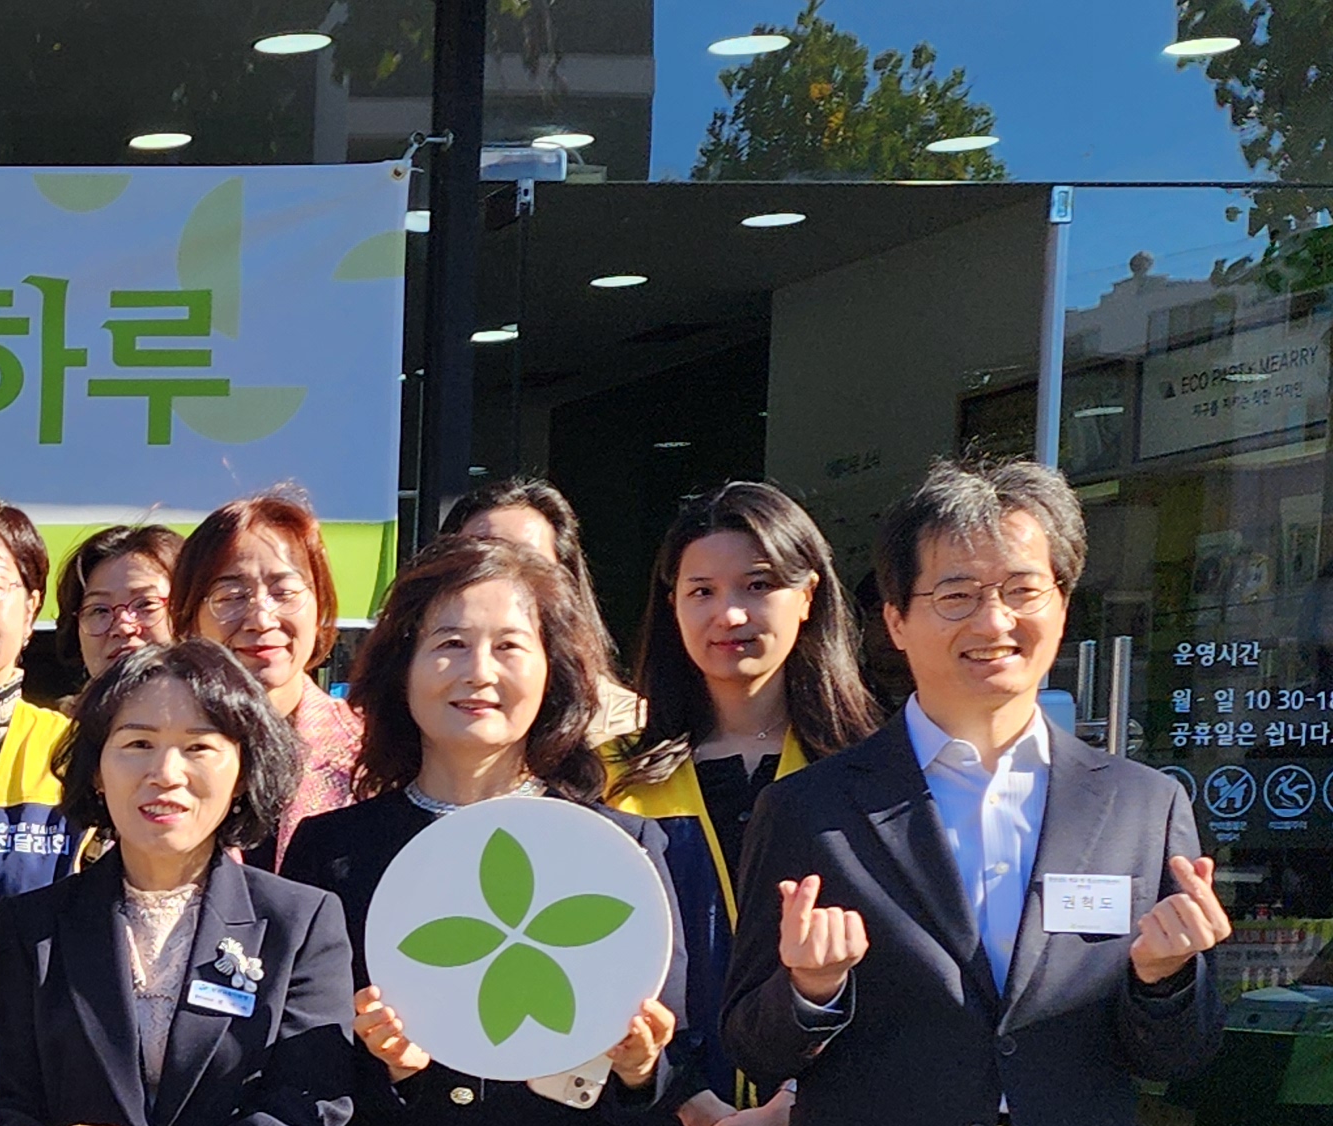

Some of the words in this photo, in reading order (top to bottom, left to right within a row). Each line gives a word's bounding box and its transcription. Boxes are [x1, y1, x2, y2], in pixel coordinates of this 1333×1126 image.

[1173, 641, 1261, 667] 운영시간
[1172, 688, 1192, 713] 월
[1214, 688, 1234, 713] 일
[1169, 721, 1257, 747] 공휴일은
